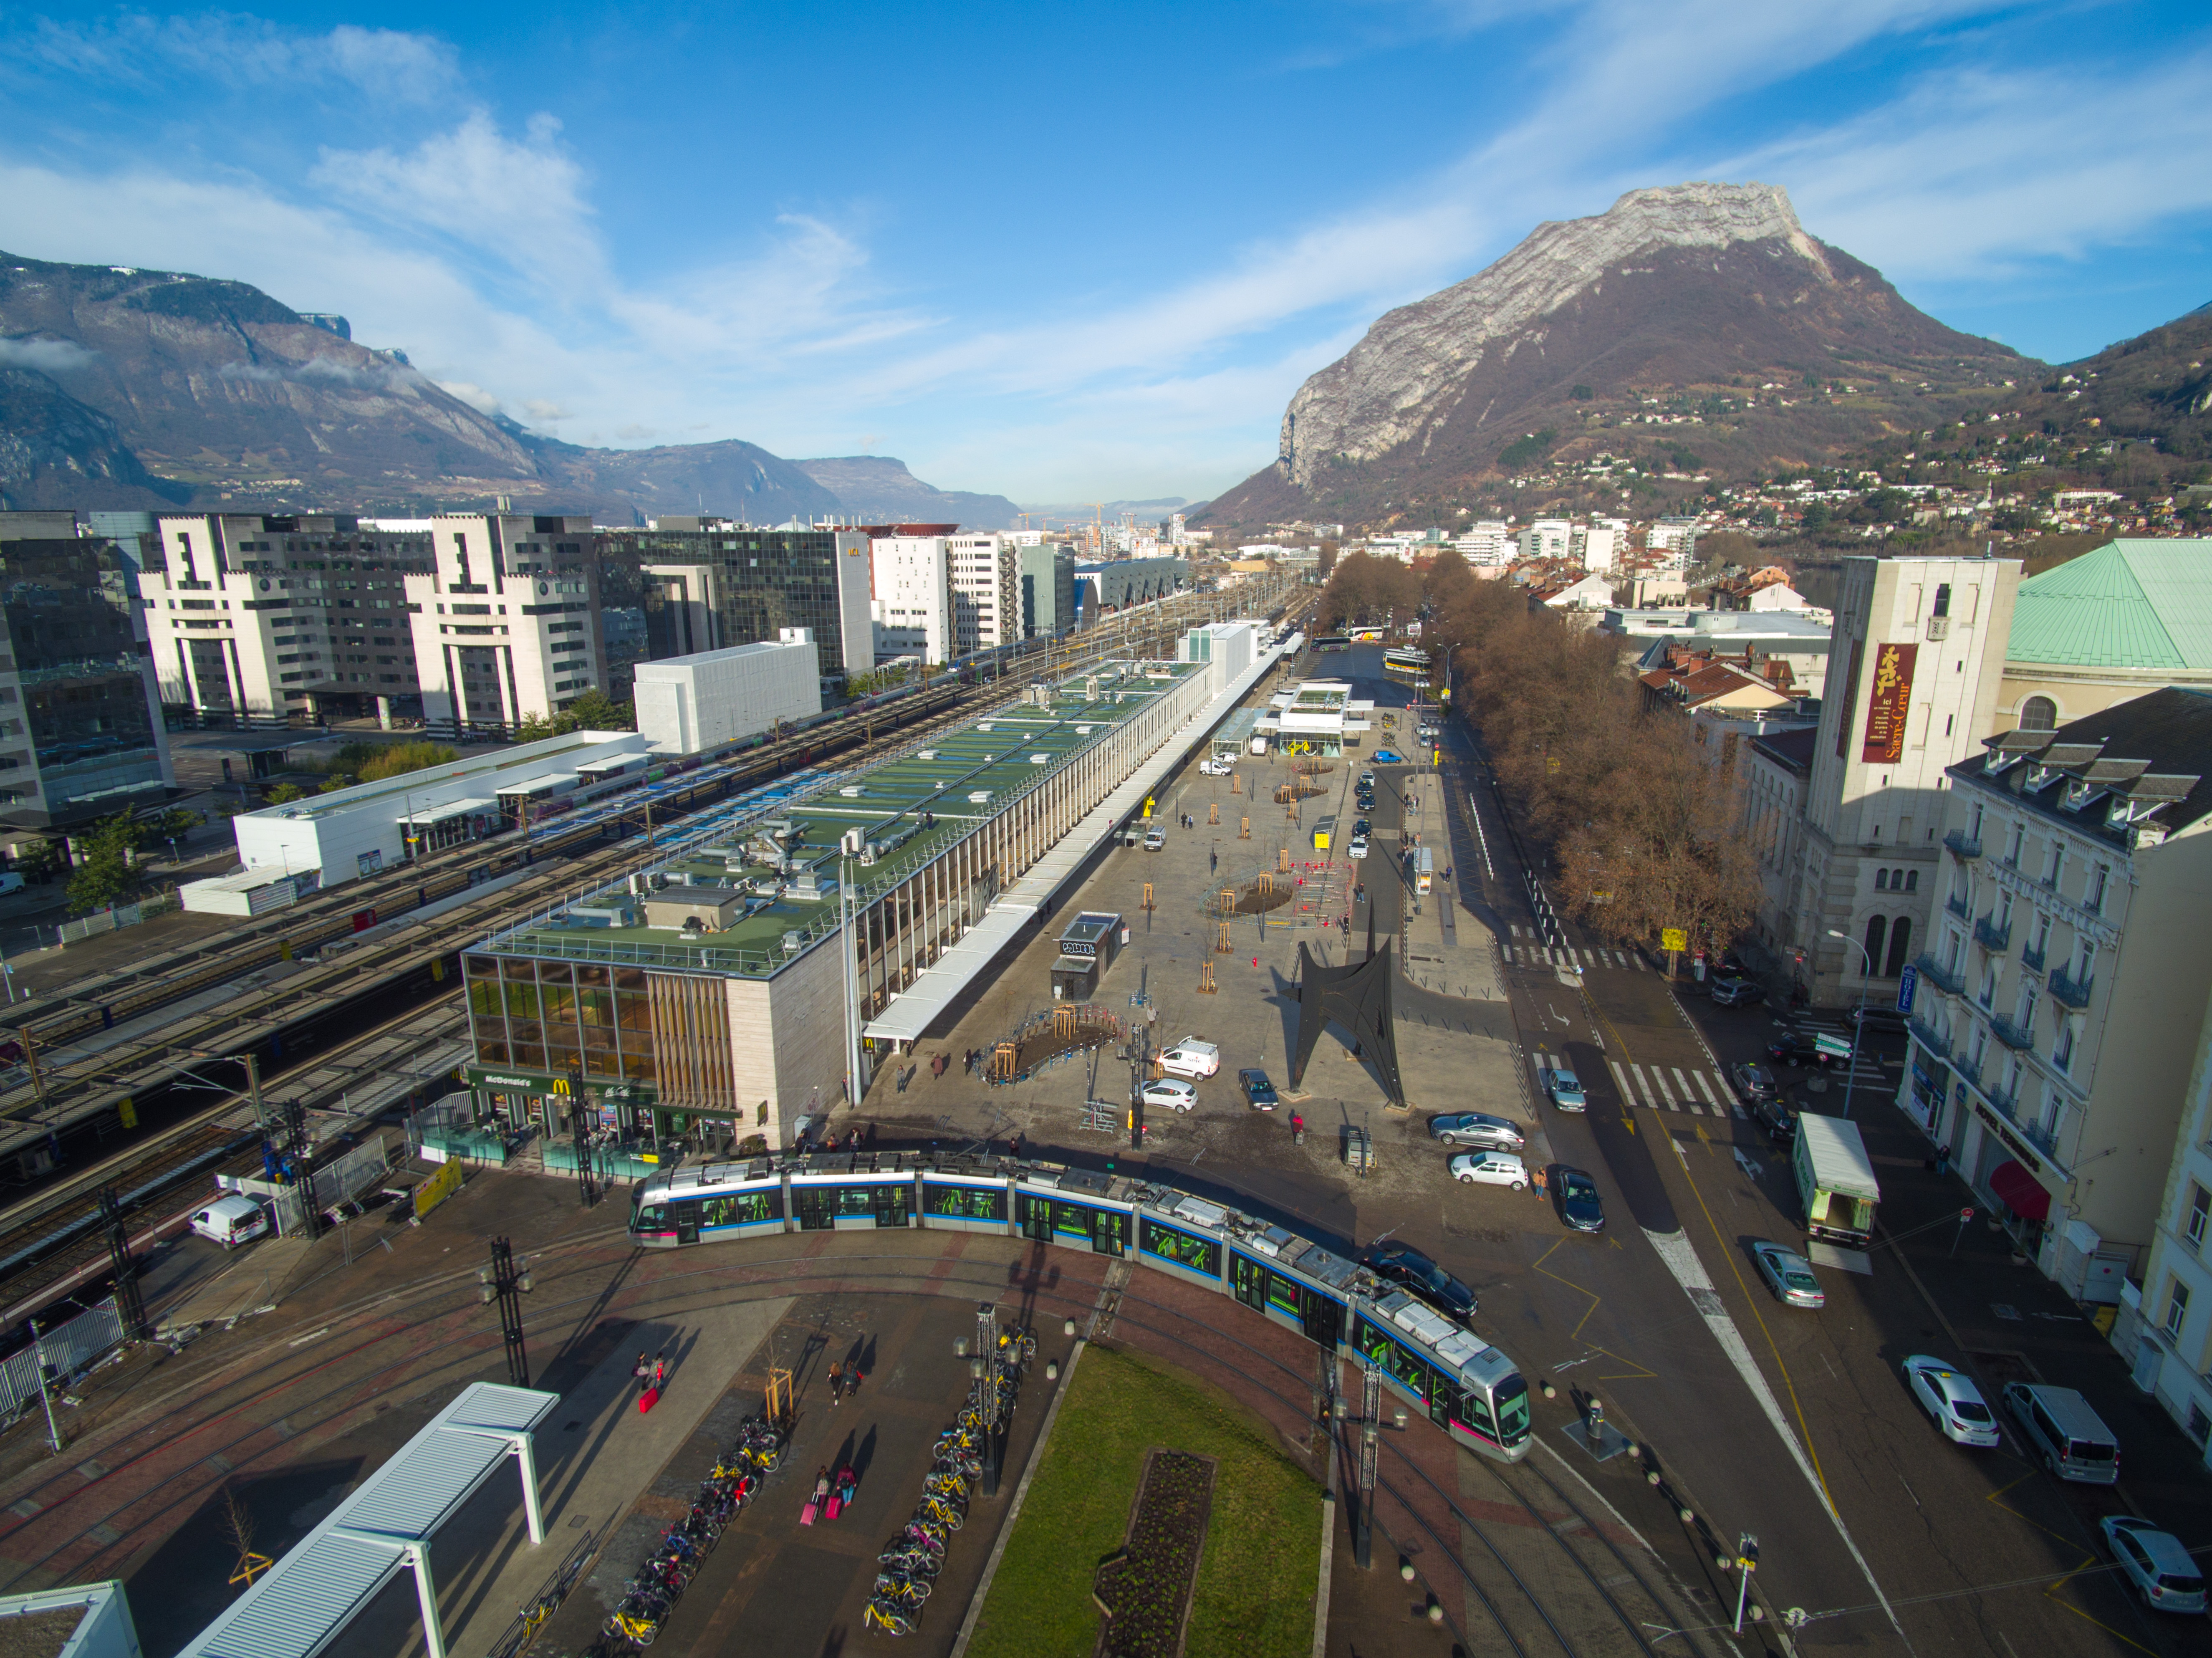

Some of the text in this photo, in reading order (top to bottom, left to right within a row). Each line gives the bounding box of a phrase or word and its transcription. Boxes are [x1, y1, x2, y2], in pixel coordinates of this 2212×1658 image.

[1886, 683, 1909, 758] Sacré-Cœur
[1903, 978, 1912, 1007] HOTEL
[485, 1075, 531, 1087] McDonald's
[1975, 1102, 1999, 1133] HOTEL
